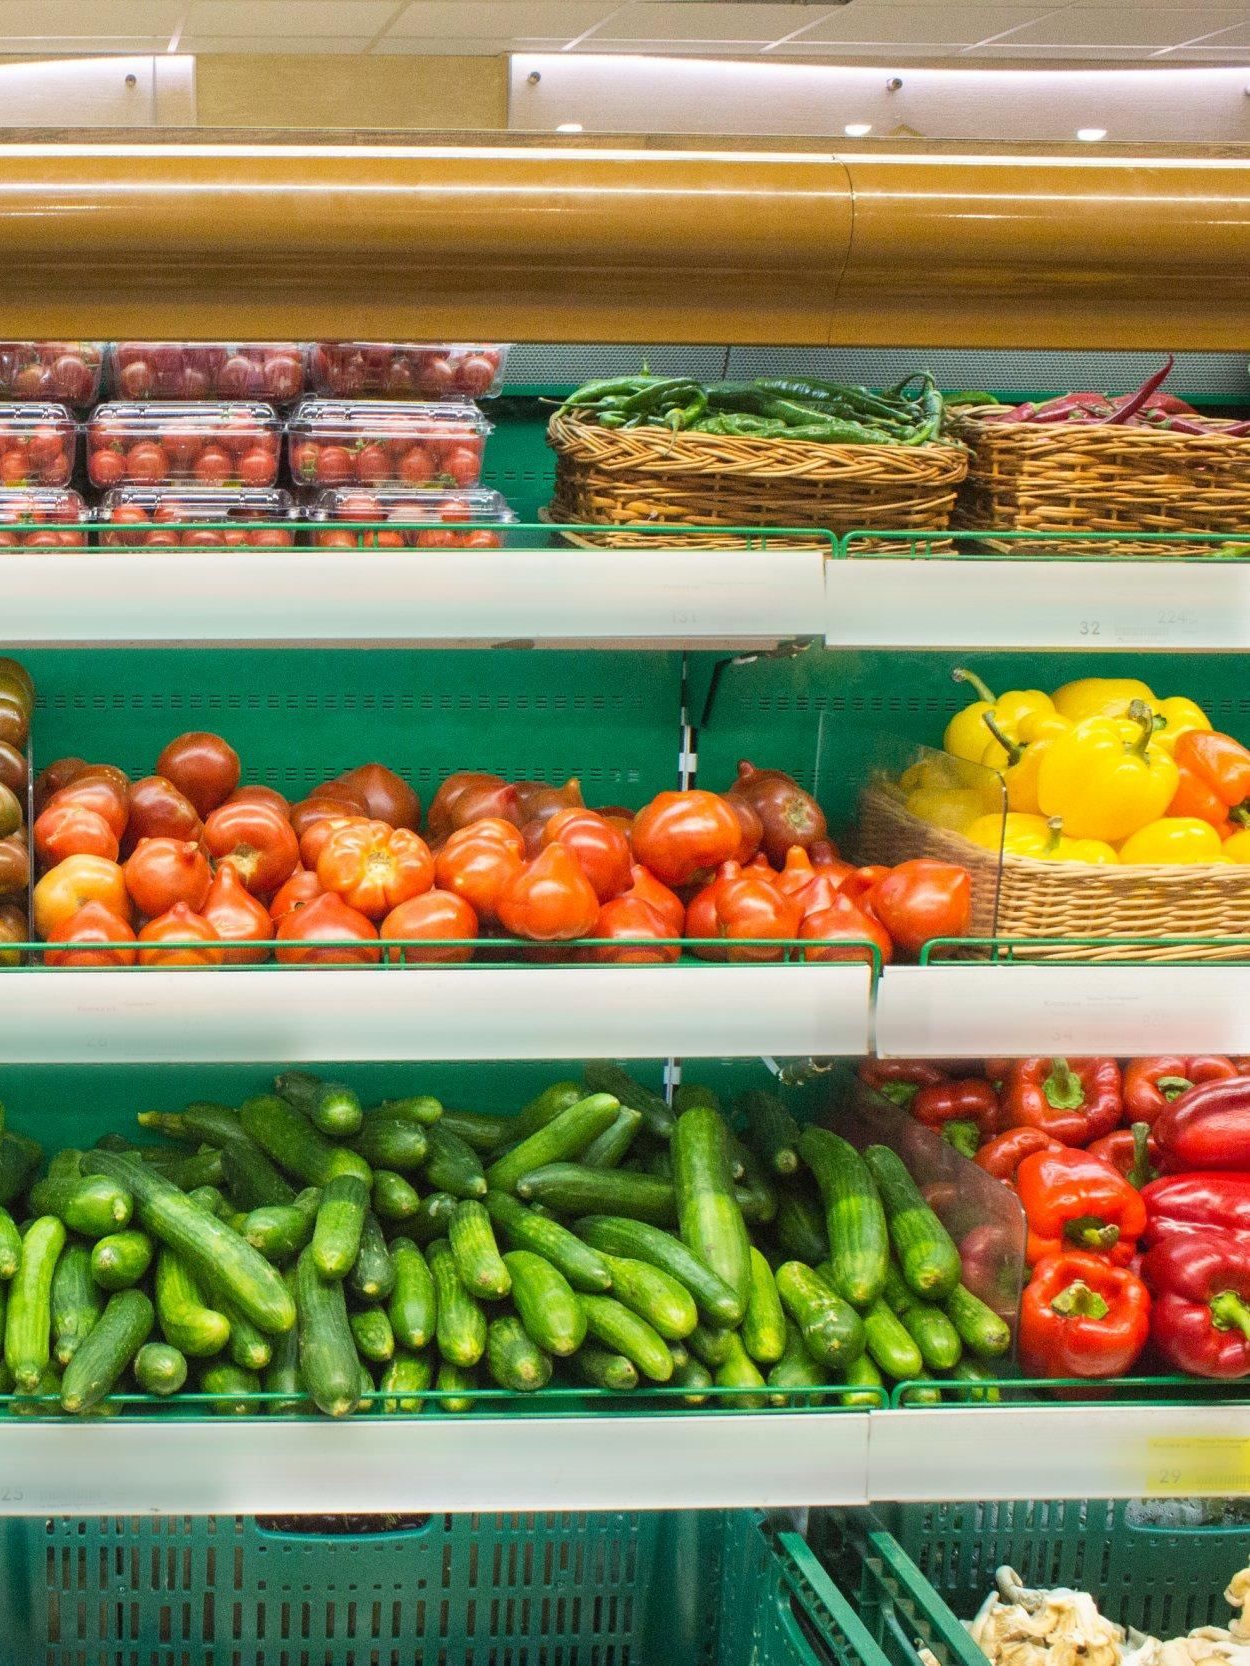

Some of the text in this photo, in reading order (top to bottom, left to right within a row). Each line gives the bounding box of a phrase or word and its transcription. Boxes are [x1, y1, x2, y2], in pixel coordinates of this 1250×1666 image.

[1079, 621, 1101, 635] 32
[1159, 1469, 1182, 1484] 29
[1, 1486, 24, 1501] 25
